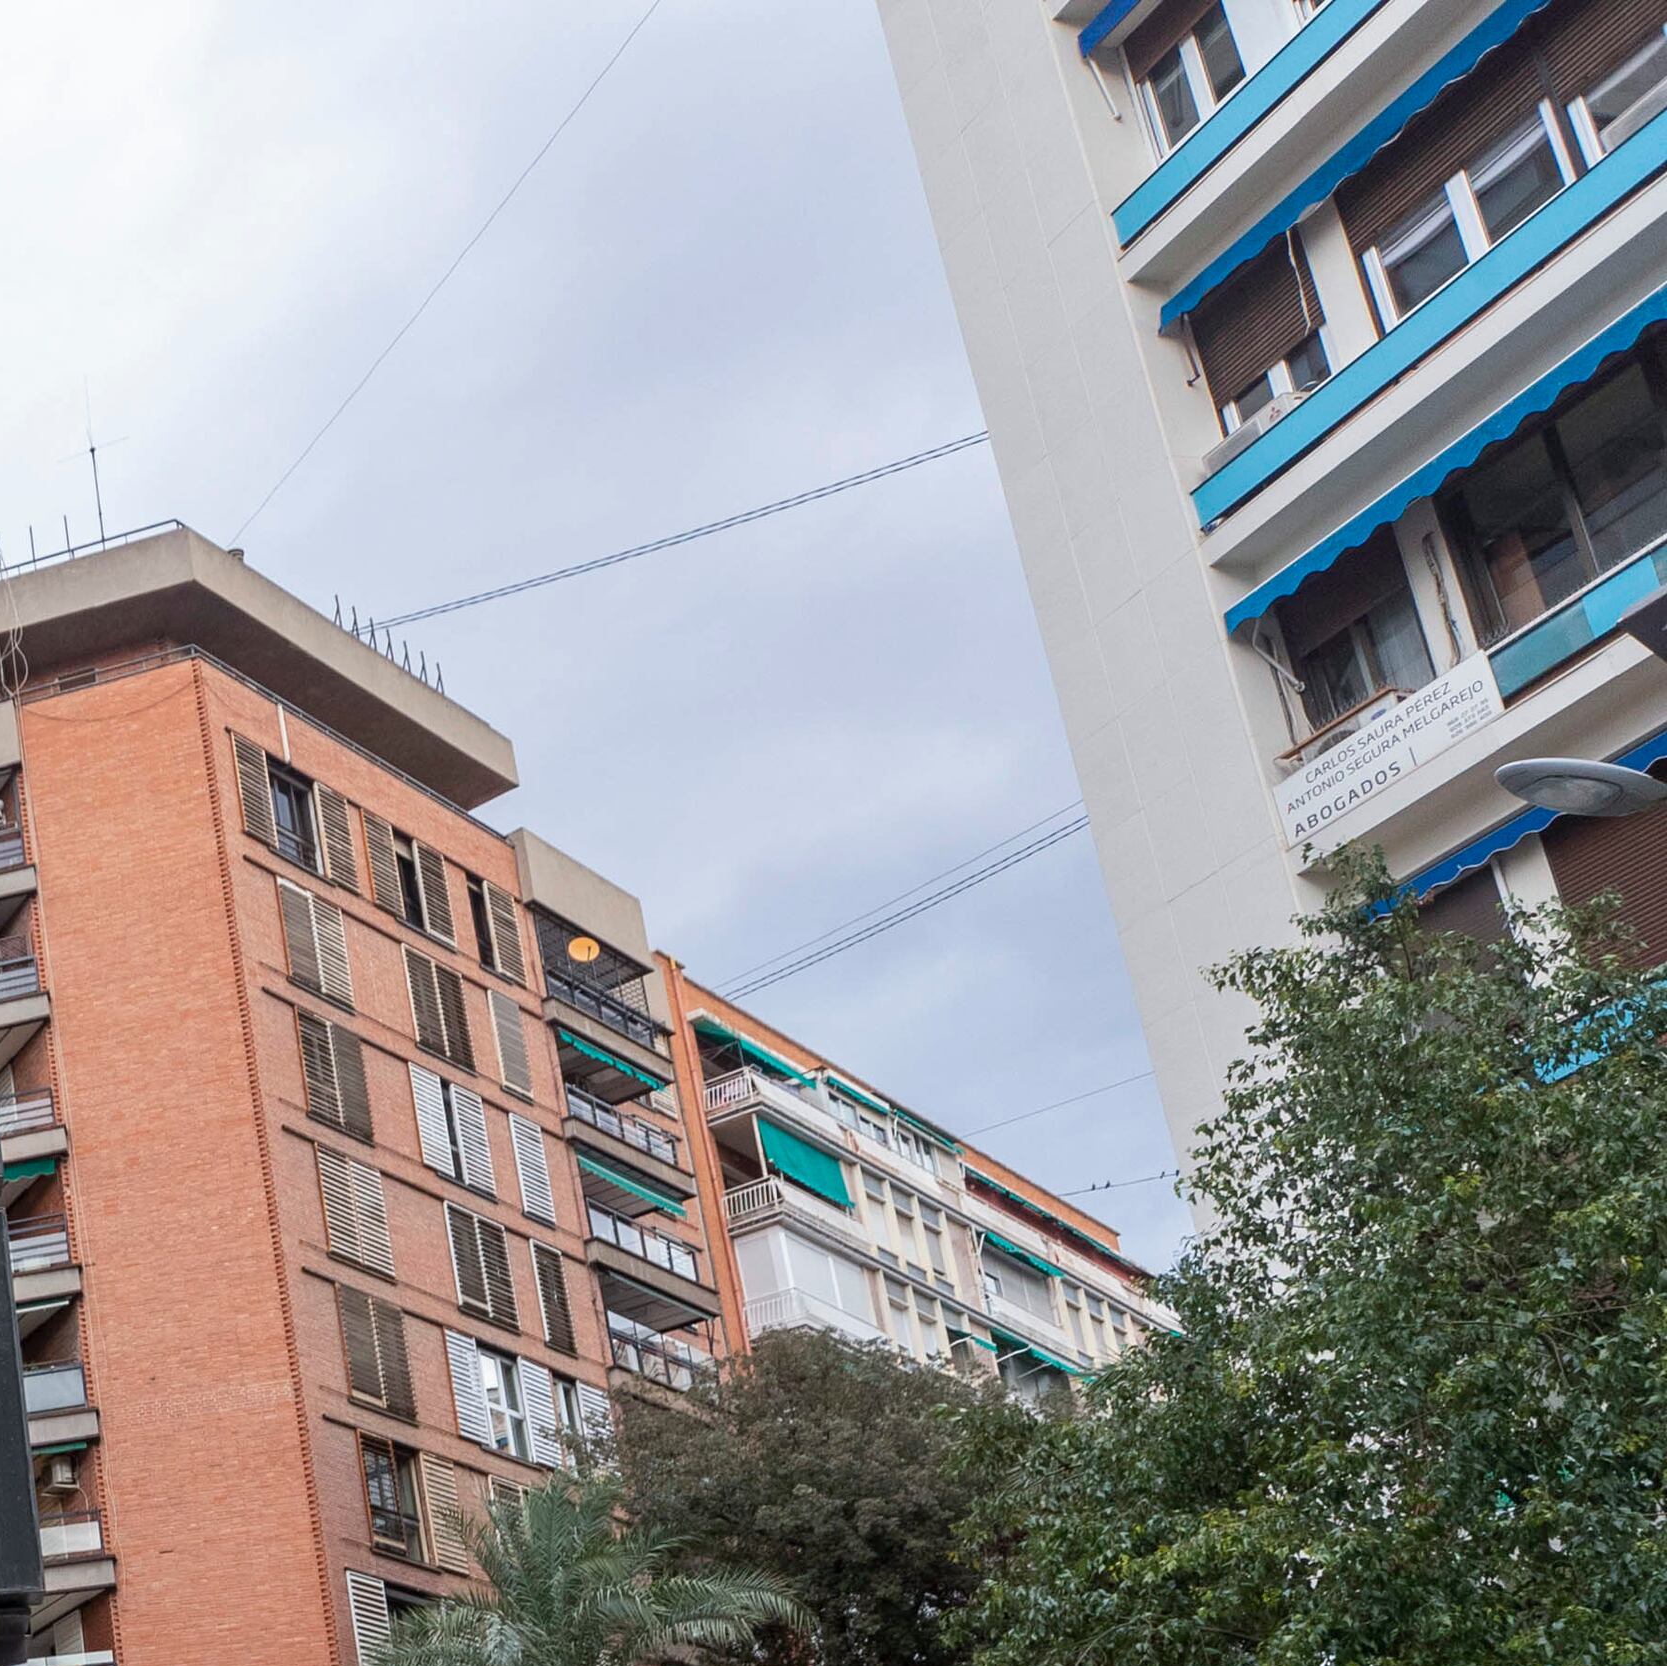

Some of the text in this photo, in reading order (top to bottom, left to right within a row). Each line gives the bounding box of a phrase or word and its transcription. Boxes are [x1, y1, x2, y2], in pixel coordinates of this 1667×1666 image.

[1287, 770, 1346, 815] ANTONIO
[1347, 735, 1402, 777] SEGURA
[1403, 679, 1484, 739] MELGAREJO
[1305, 746, 1357, 784] CARLOS
[1357, 712, 1404, 749] SAURA
[1294, 760, 1402, 838] ABOGADOS
